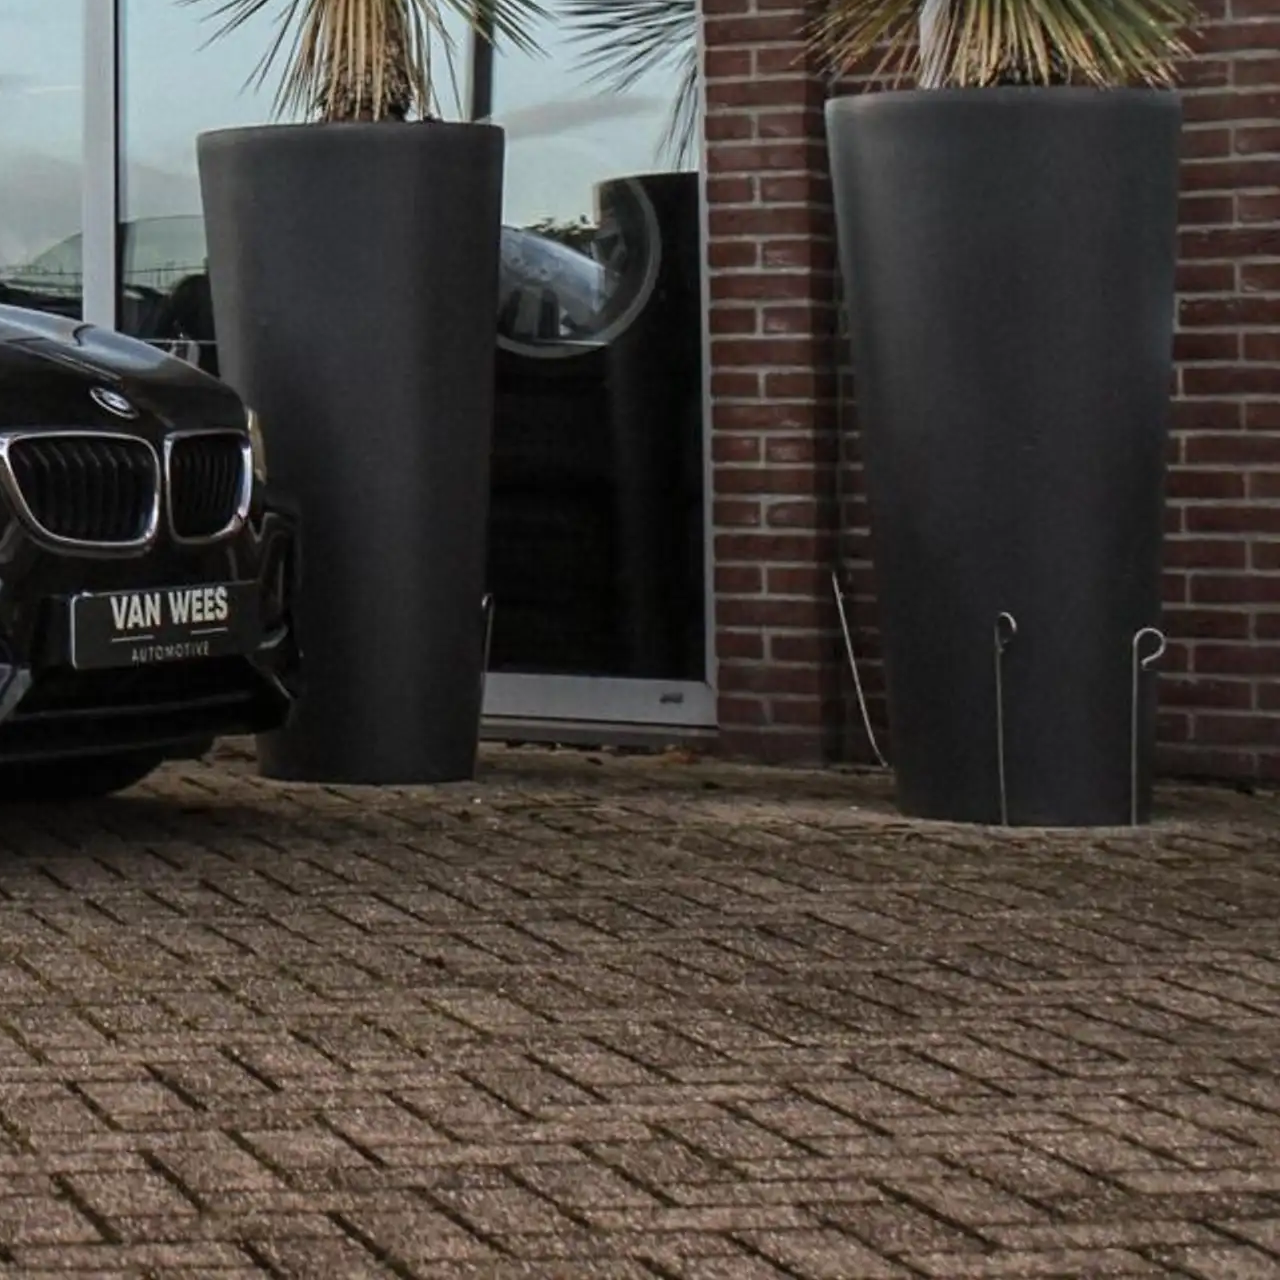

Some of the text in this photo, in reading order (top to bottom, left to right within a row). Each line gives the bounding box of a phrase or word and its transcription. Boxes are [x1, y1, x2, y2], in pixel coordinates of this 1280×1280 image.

[110, 586, 228, 631] VAN WEES
[131, 640, 210, 664] AUTOMOTIVE
